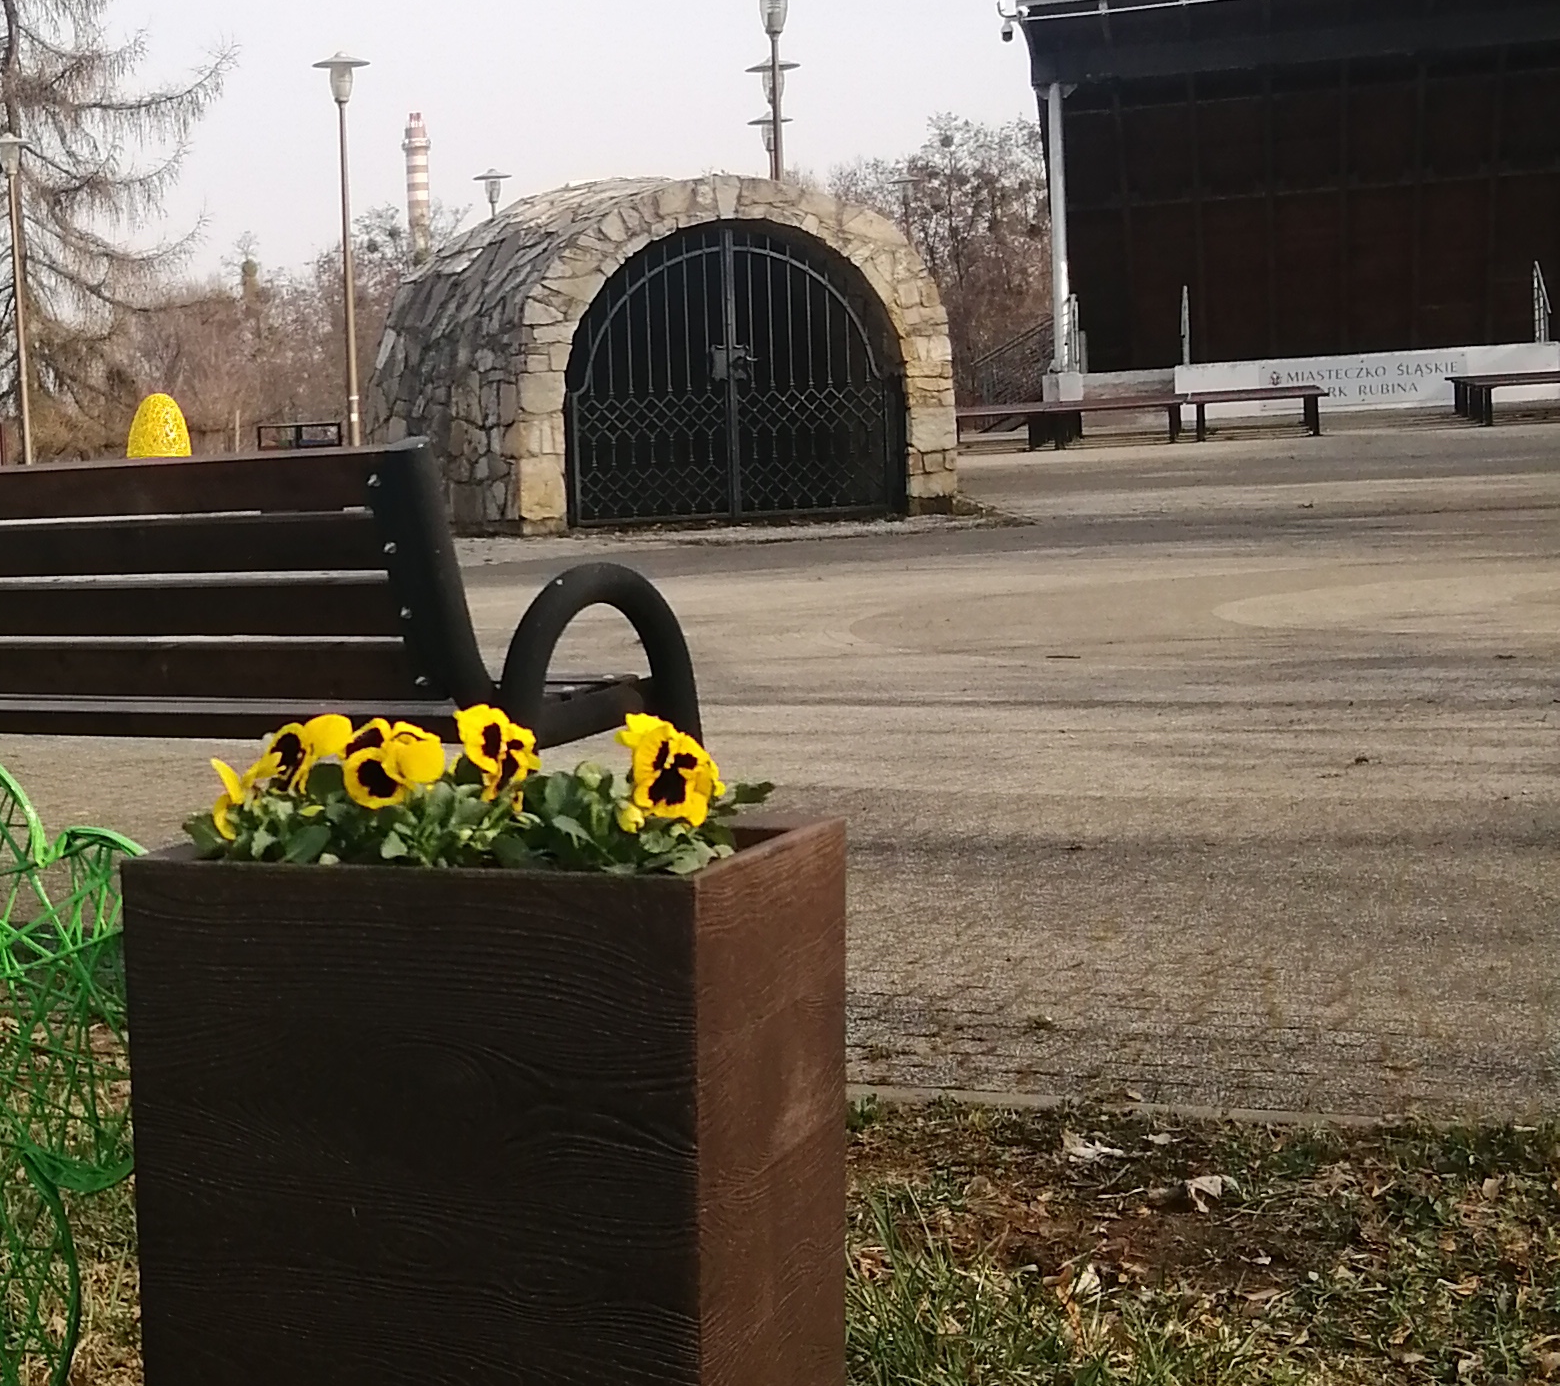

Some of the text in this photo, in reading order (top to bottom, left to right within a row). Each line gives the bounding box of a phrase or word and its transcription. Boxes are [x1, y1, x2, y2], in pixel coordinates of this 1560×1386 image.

[1286, 361, 1458, 383] MIASTECZKO ŚLĄSKIE
[1327, 382, 1419, 398] RK RUBINA
